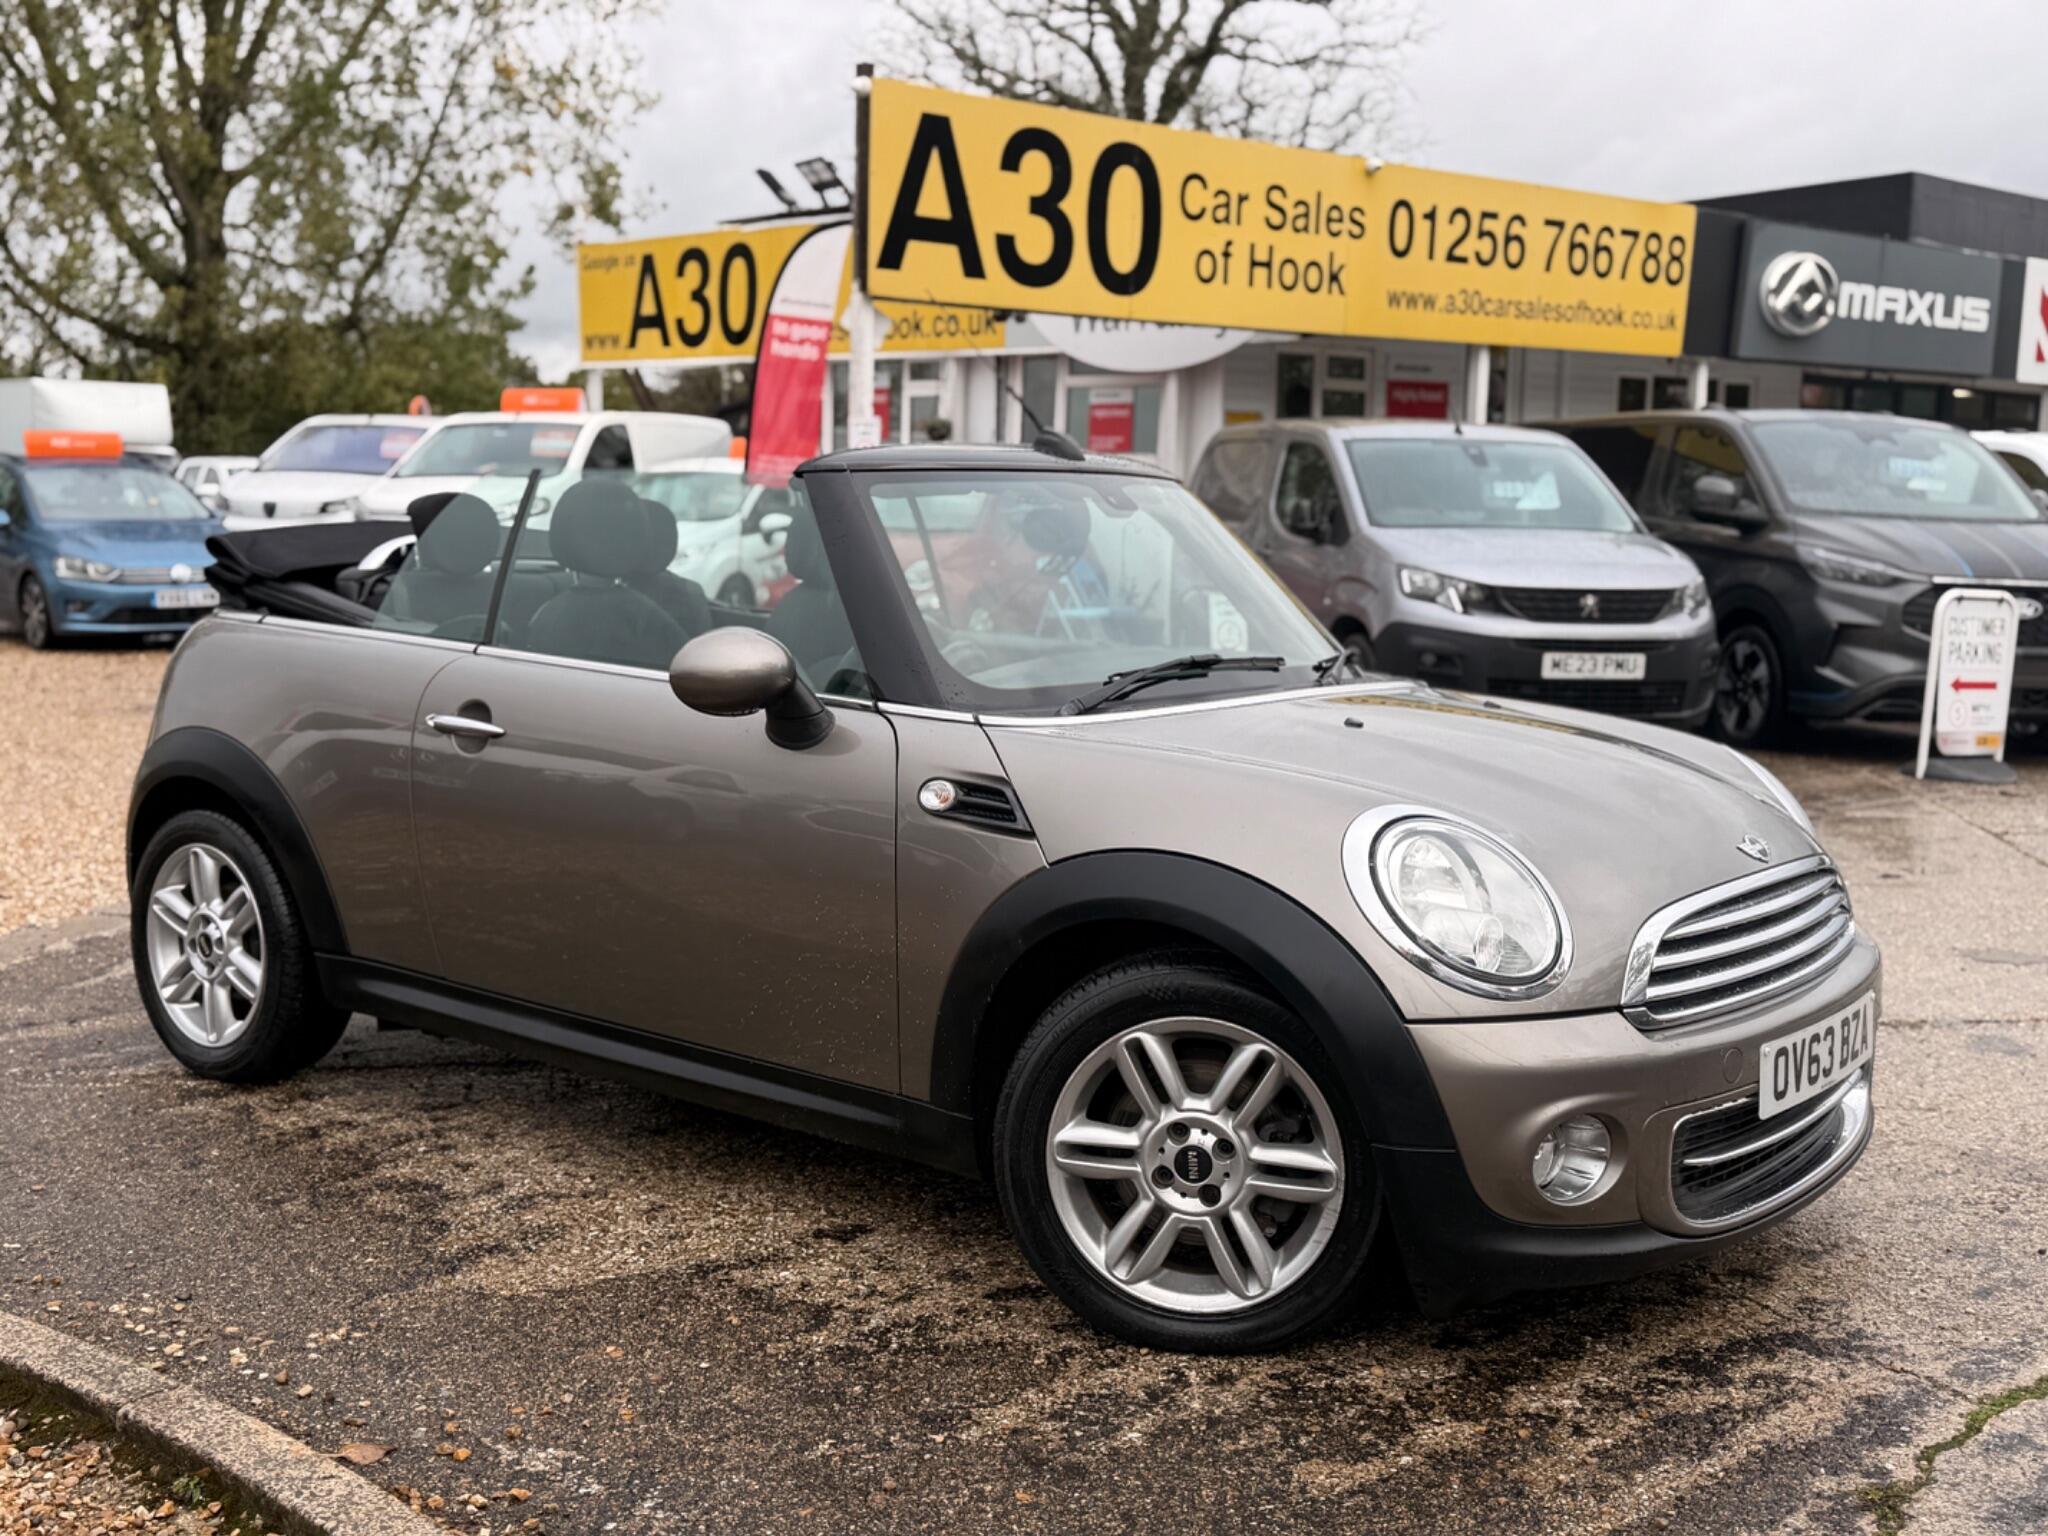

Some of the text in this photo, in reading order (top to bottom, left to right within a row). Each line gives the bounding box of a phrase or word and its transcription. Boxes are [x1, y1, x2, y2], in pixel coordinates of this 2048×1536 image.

[876, 112, 1162, 296] A30
[1180, 173, 1366, 239] Car Sales
[1195, 239, 1345, 296] of Hook
[1388, 199, 1686, 286] 01256 766788
[628, 242, 757, 348] A30
[1386, 287, 1679, 331] www.a30carsalesofhook.co.uk
[1837, 280, 1992, 334] MAXUS
[1947, 641, 2002, 666] PARKING
[1948, 615, 2006, 639] CUSTOMER
[1774, 1003, 1868, 1101] OV63 BZA
[1187, 1150, 1201, 1180] MINI
